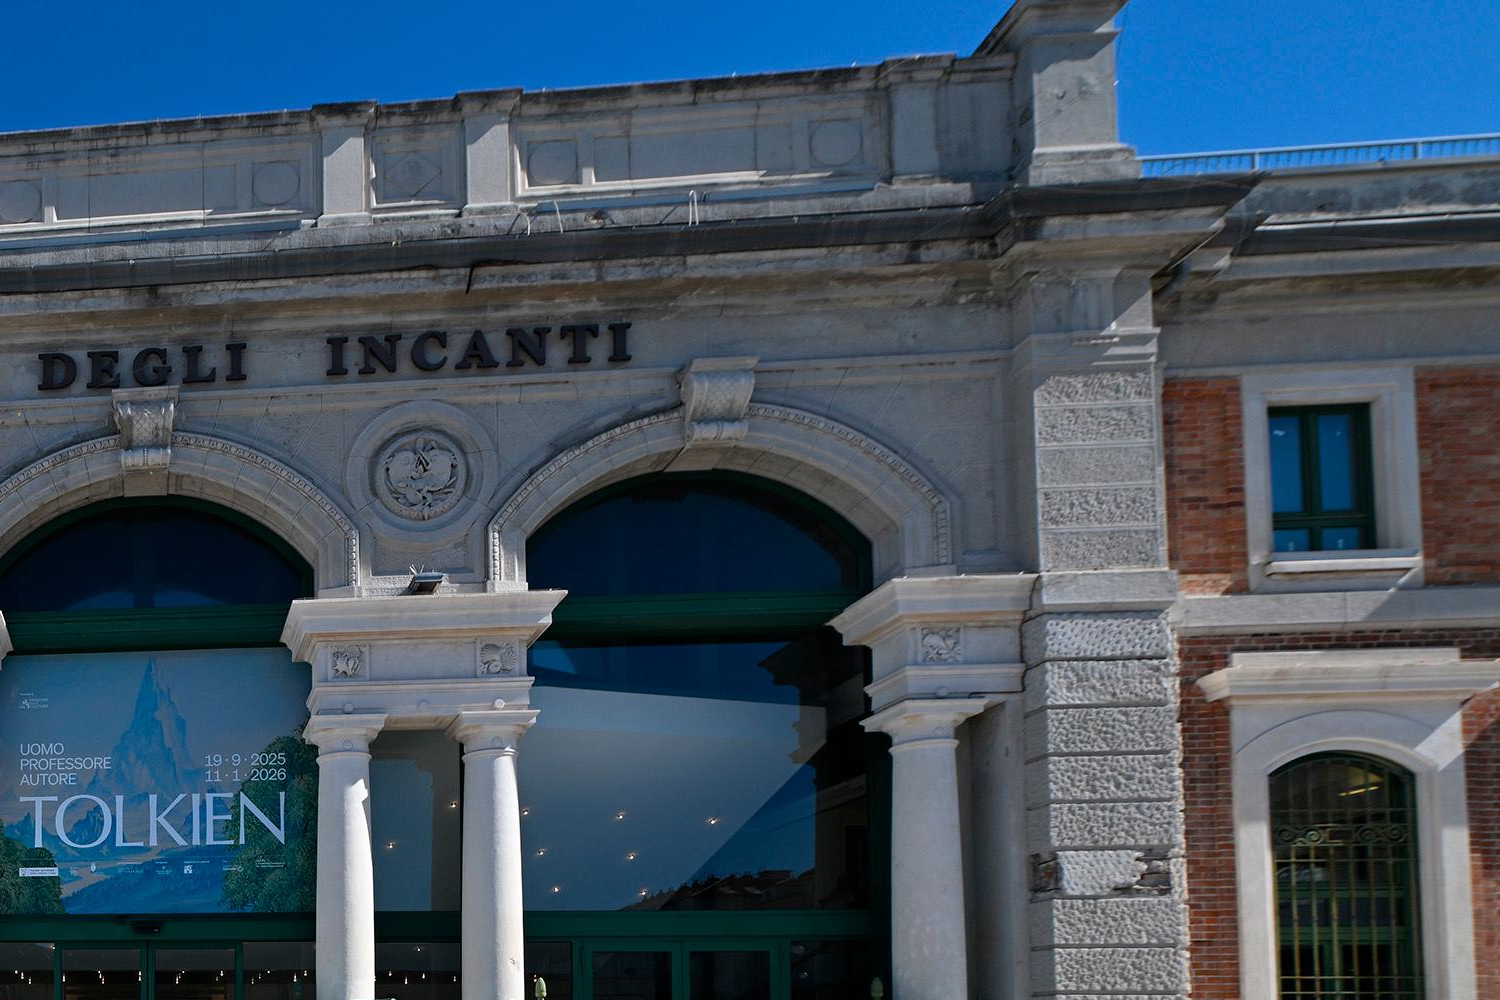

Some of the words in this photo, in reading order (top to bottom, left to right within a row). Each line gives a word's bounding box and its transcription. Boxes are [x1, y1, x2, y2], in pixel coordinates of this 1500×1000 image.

[37, 341, 248, 391] DEGLI
[326, 321, 634, 377] INCANTI
[20, 742, 65, 756] UOMO
[20, 756, 112, 771] PROFESSORE
[20, 772, 77, 786] AUTORE
[19, 791, 286, 849] TOLKIEN
